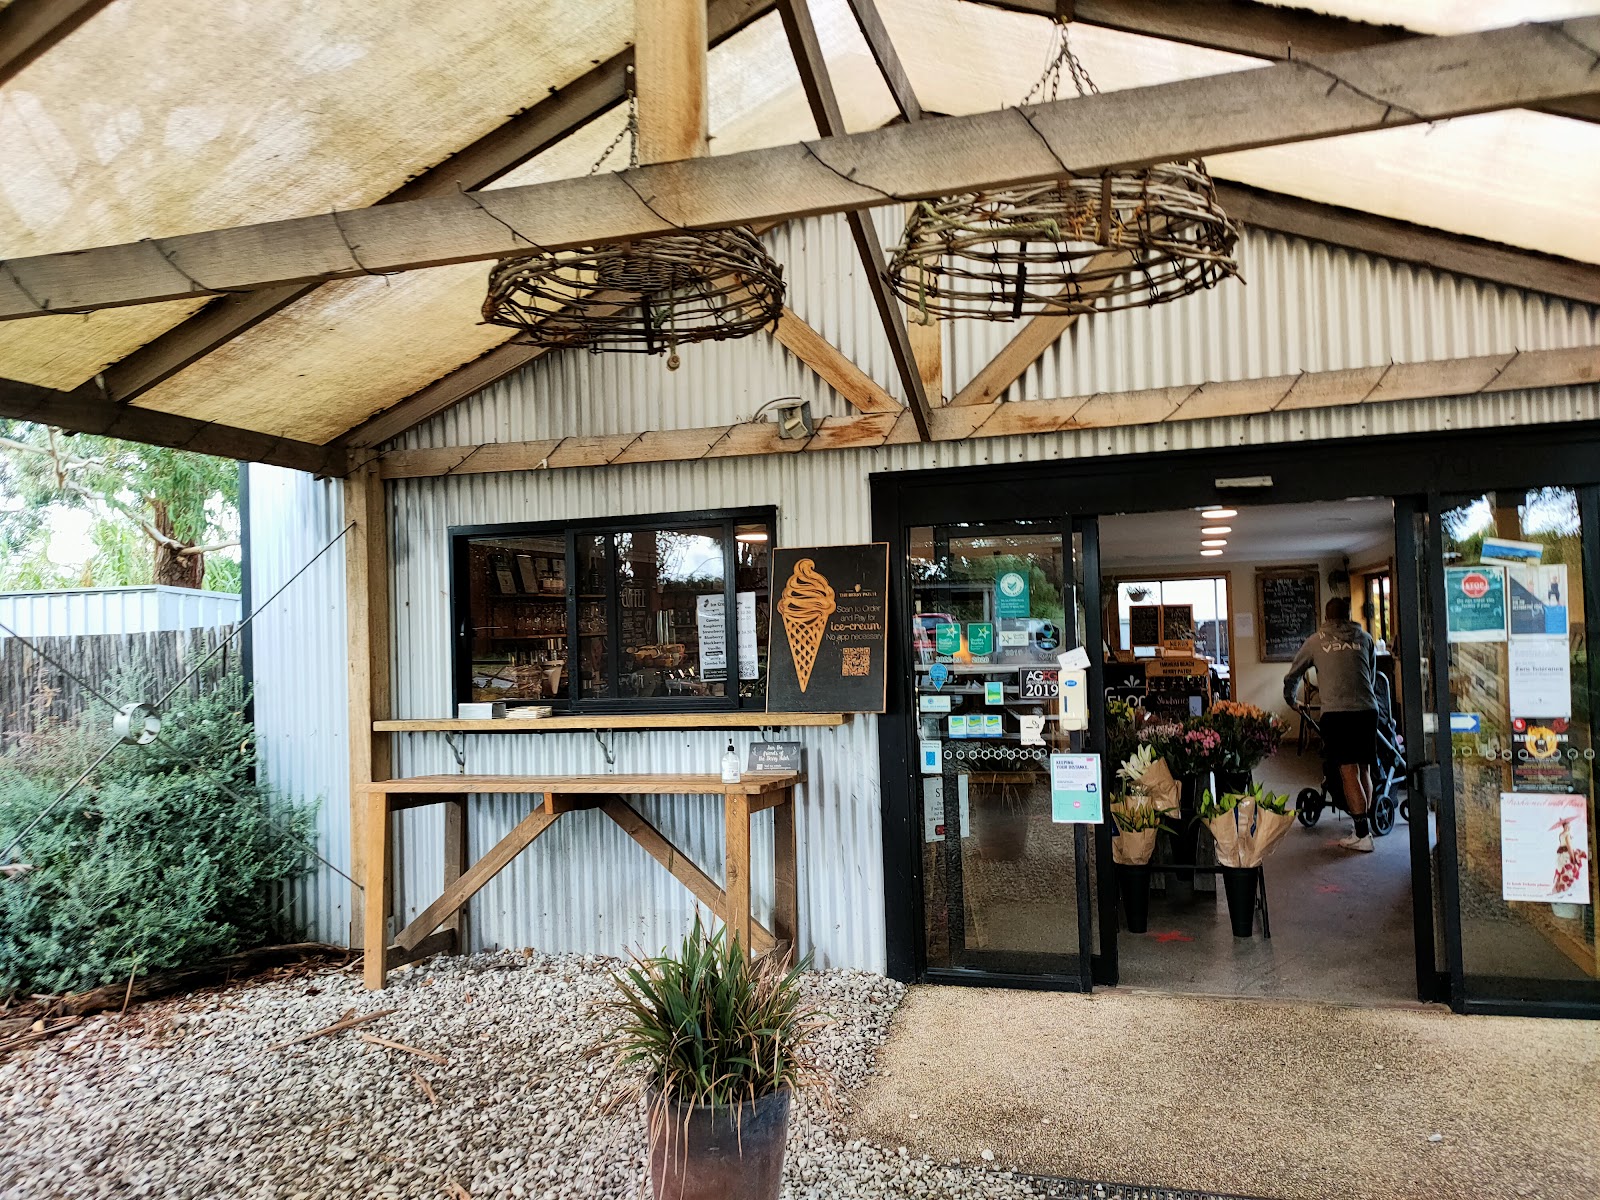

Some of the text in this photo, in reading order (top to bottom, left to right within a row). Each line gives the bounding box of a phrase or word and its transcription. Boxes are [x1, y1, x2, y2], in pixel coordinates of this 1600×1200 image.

[1465, 581, 1486, 590] STOP
[836, 605, 854, 613] Scan
[862, 604, 882, 612] Order
[854, 614, 866, 623] Pay
[830, 622, 882, 632] ice-cream
[836, 634, 850, 642] app
[850, 633, 884, 642] necessary
[1026, 670, 1058, 681] AGFG
[1026, 684, 1059, 697] 2019
[1514, 734, 1536, 742] RING
[1546, 734, 1569, 742] FIRE
